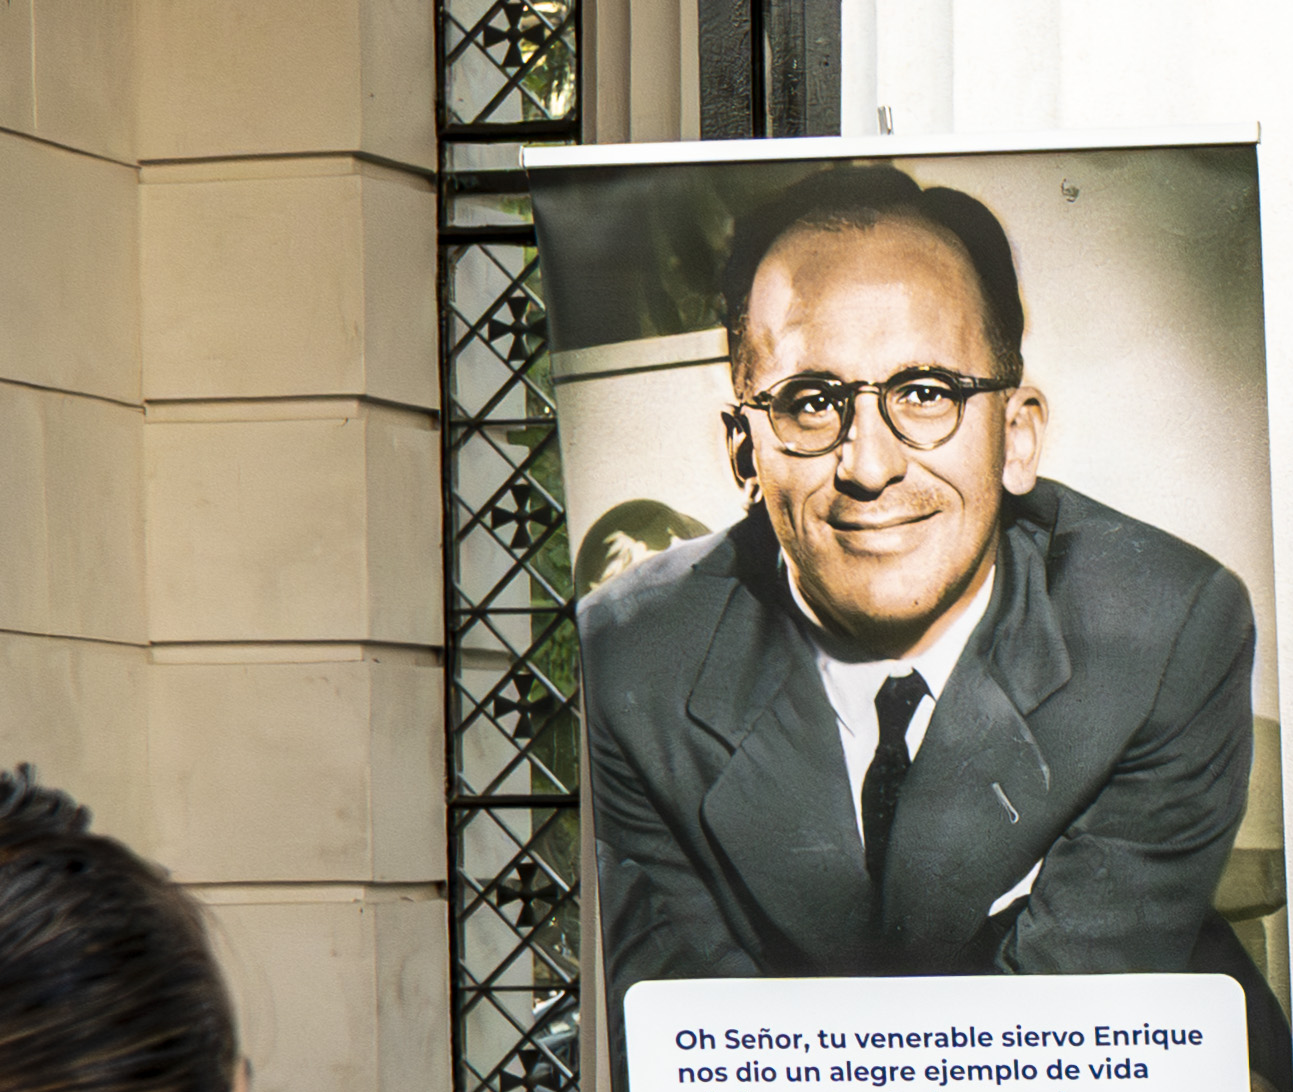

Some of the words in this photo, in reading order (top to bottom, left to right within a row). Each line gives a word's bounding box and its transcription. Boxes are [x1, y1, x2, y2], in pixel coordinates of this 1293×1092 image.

[675, 1028, 716, 1051] Oh
[724, 1027, 810, 1054] Señor,
[817, 1029, 847, 1049] tu
[854, 1026, 994, 1049] venerable
[1001, 1024, 1085, 1048] siervo
[1094, 1022, 1203, 1051] Enrique
[678, 1066, 728, 1084] nos
[735, 1060, 777, 1083] dio
[785, 1066, 821, 1083] un
[830, 1060, 916, 1087] alegre
[924, 1058, 1038, 1087] ejemplo
[1046, 1058, 1081, 1081] de
[1088, 1057, 1149, 1080] vida
